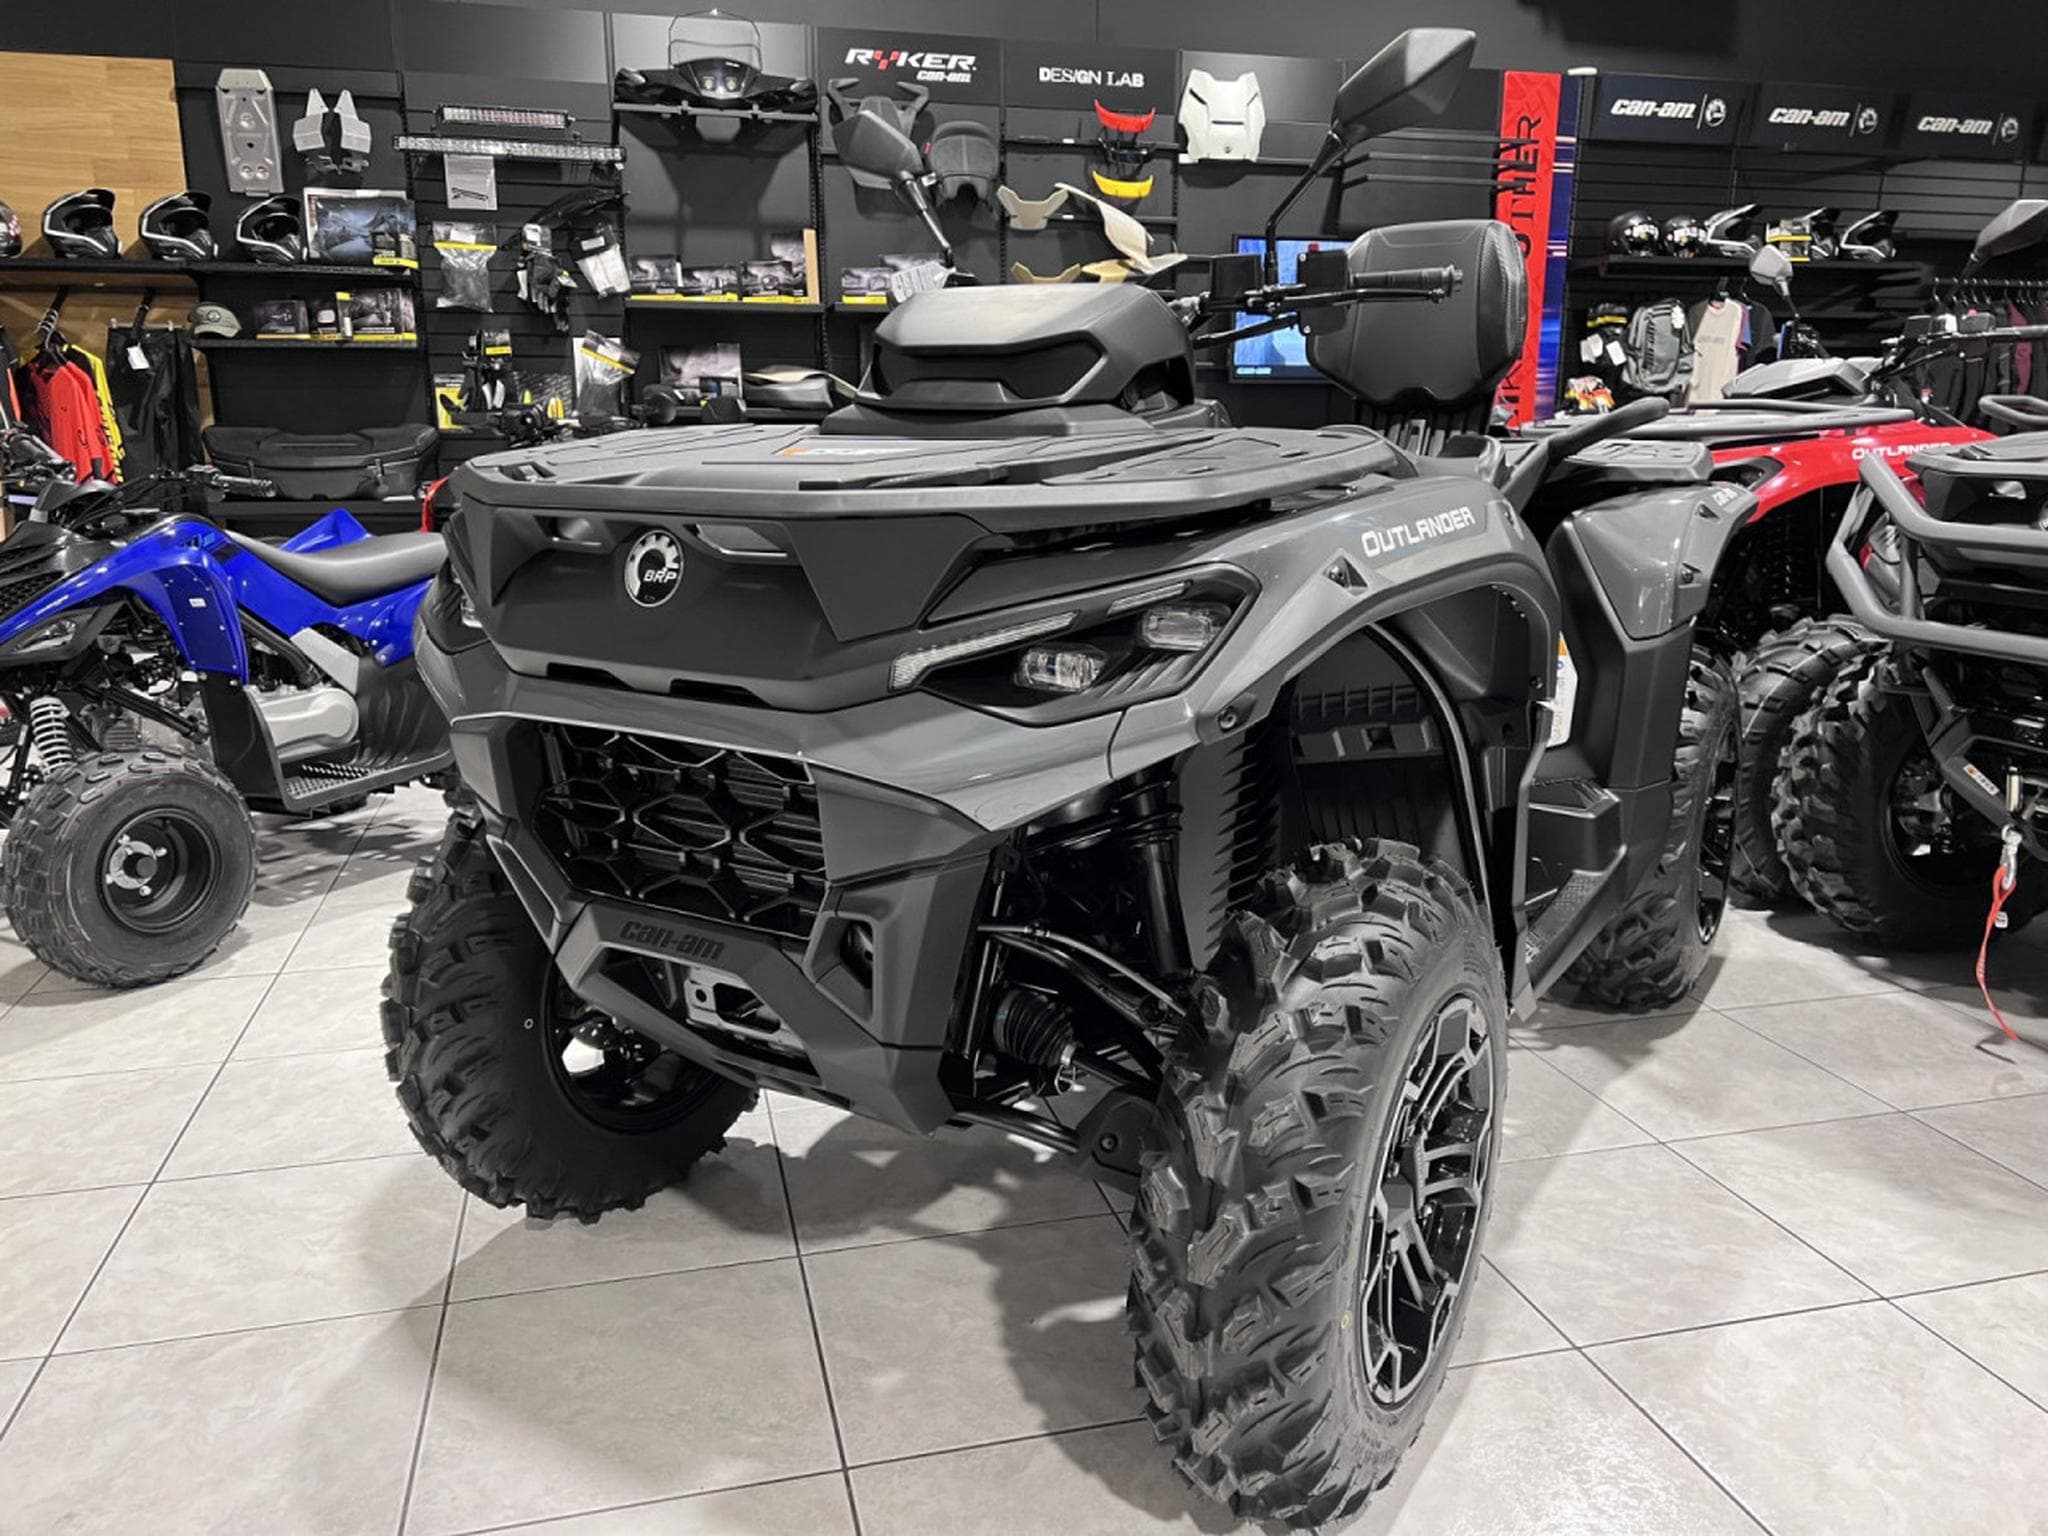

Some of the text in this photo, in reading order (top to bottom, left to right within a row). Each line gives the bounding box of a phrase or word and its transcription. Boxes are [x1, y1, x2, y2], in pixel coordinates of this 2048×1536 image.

[845, 48, 976, 71] RYKER
[1039, 66, 1145, 88] DESIGN LAB
[1610, 99, 1697, 119] can-am
[1768, 107, 1850, 126] can-am
[1917, 116, 1993, 135] can-am
[1361, 506, 1476, 558] OUTLANDER
[642, 568, 678, 583] BRP
[619, 920, 726, 961] can-am
